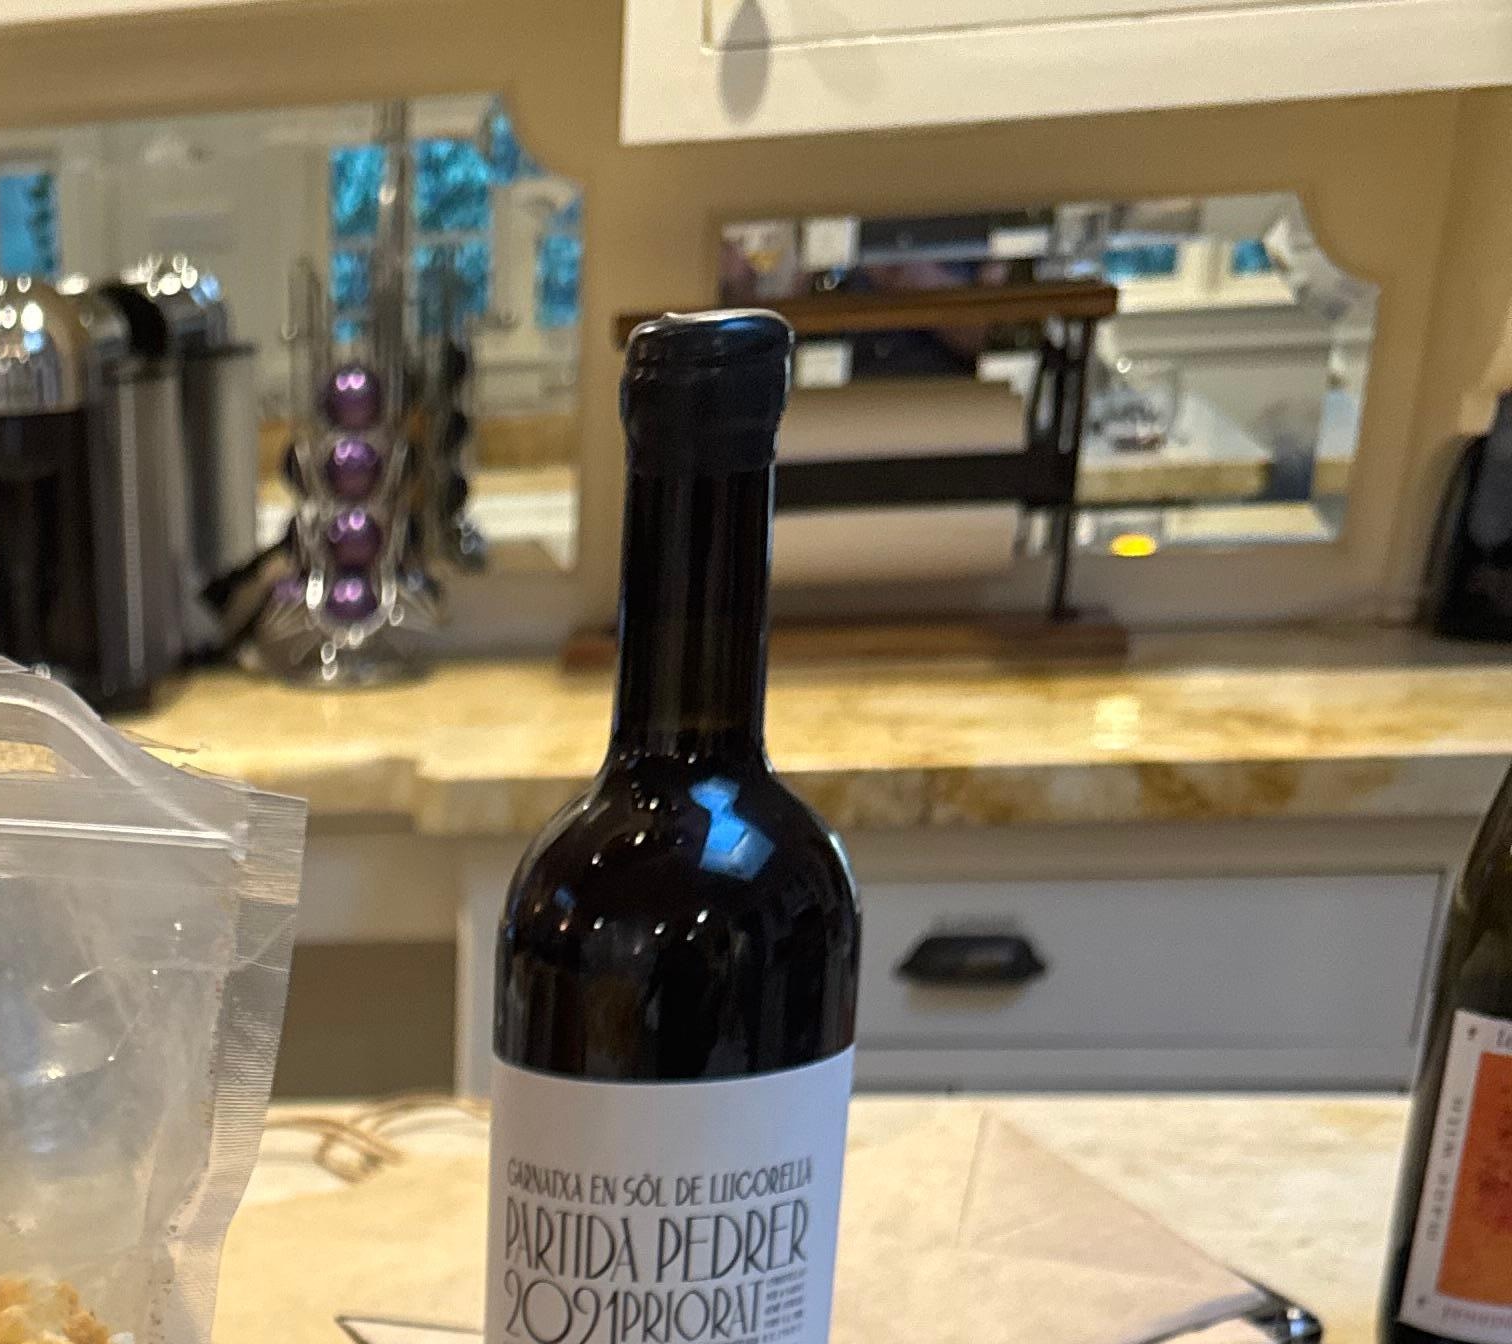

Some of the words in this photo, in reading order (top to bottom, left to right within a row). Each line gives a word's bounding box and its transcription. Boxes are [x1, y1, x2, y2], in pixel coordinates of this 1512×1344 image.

[589, 1174, 618, 1206] EN
[674, 1174, 704, 1207] DE
[504, 1195, 639, 1284] PARTIDA
[656, 1198, 810, 1284] PEDRER
[620, 1279, 765, 1344] PRIORAT
